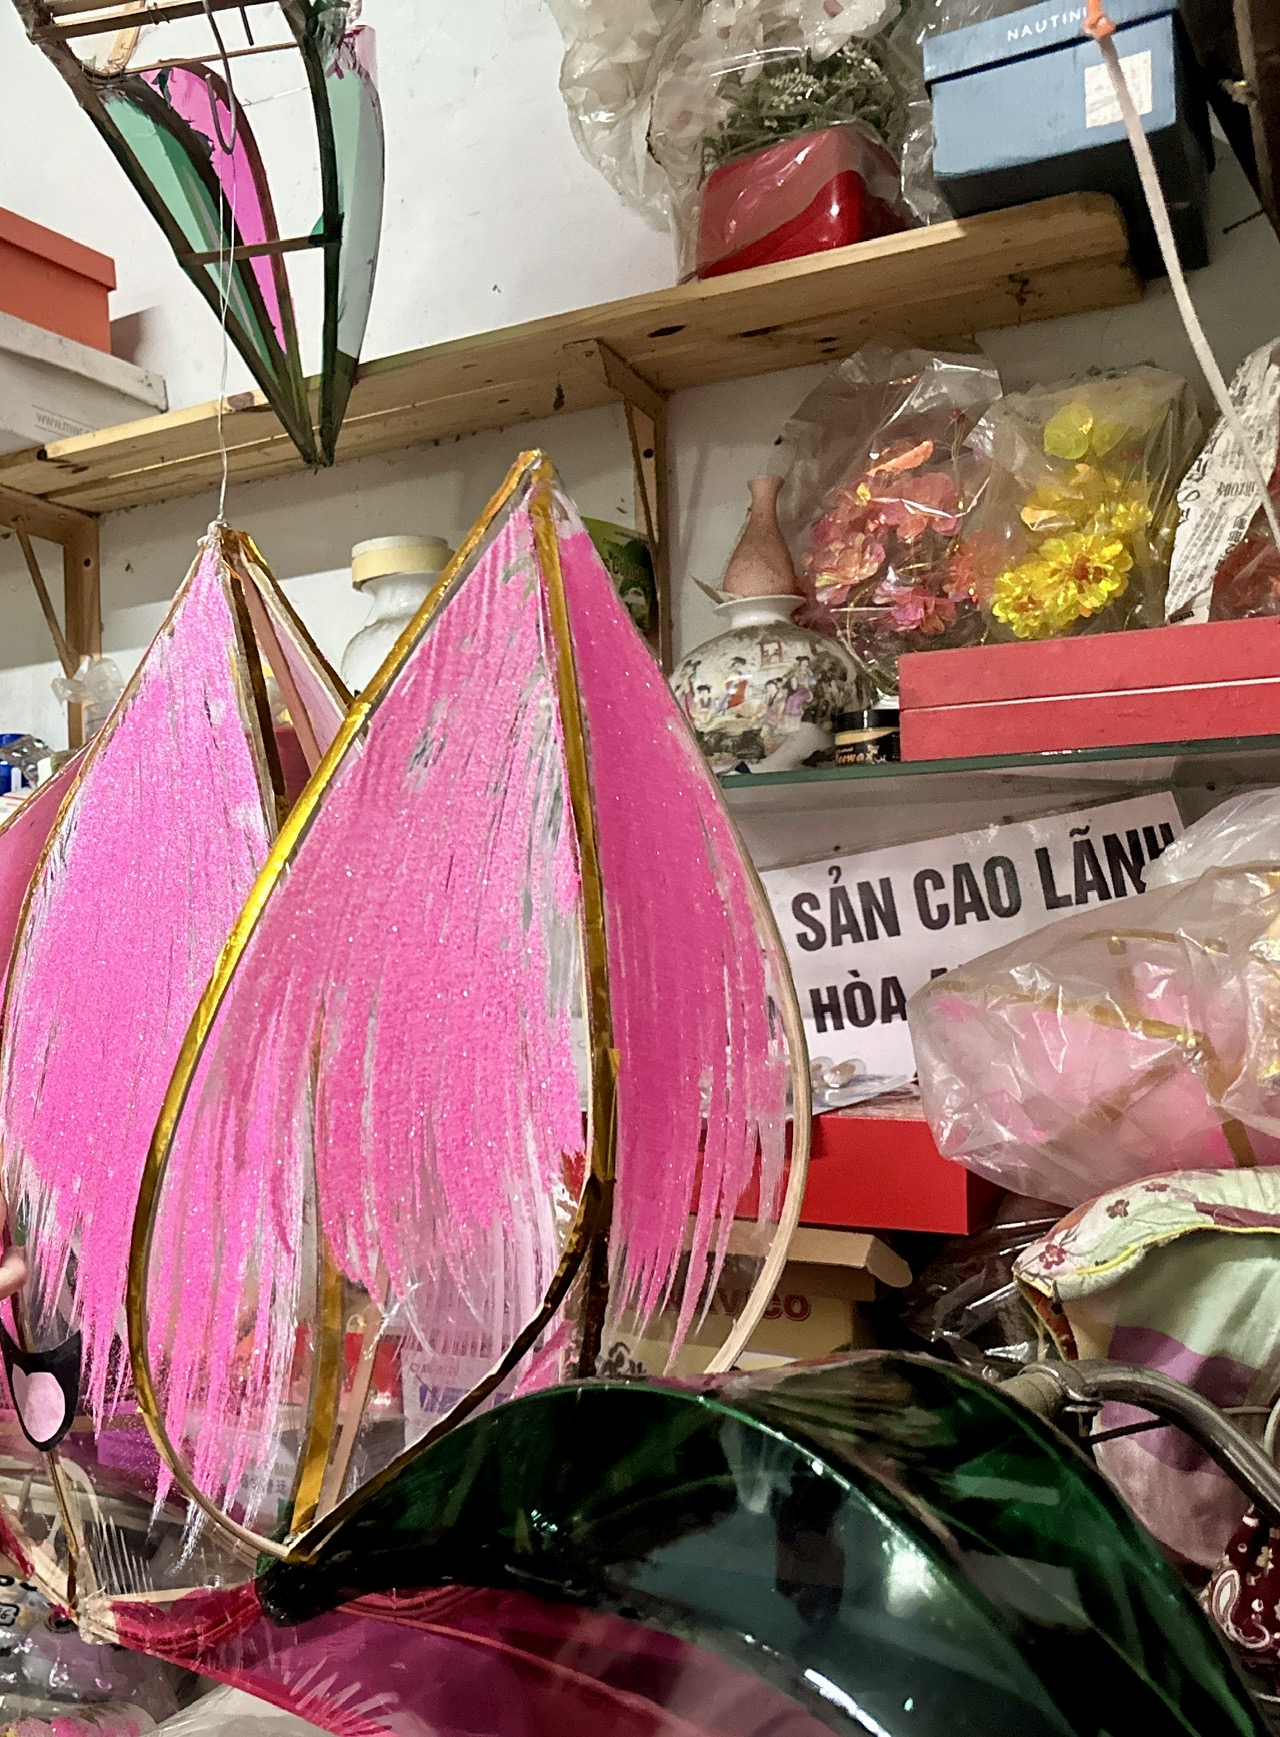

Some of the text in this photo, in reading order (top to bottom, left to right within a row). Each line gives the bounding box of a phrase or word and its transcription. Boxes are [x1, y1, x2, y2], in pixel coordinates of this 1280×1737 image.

[791, 866, 901, 952] SẢN
[913, 854, 1023, 931] CAO
[809, 969, 908, 1034] HÒA
